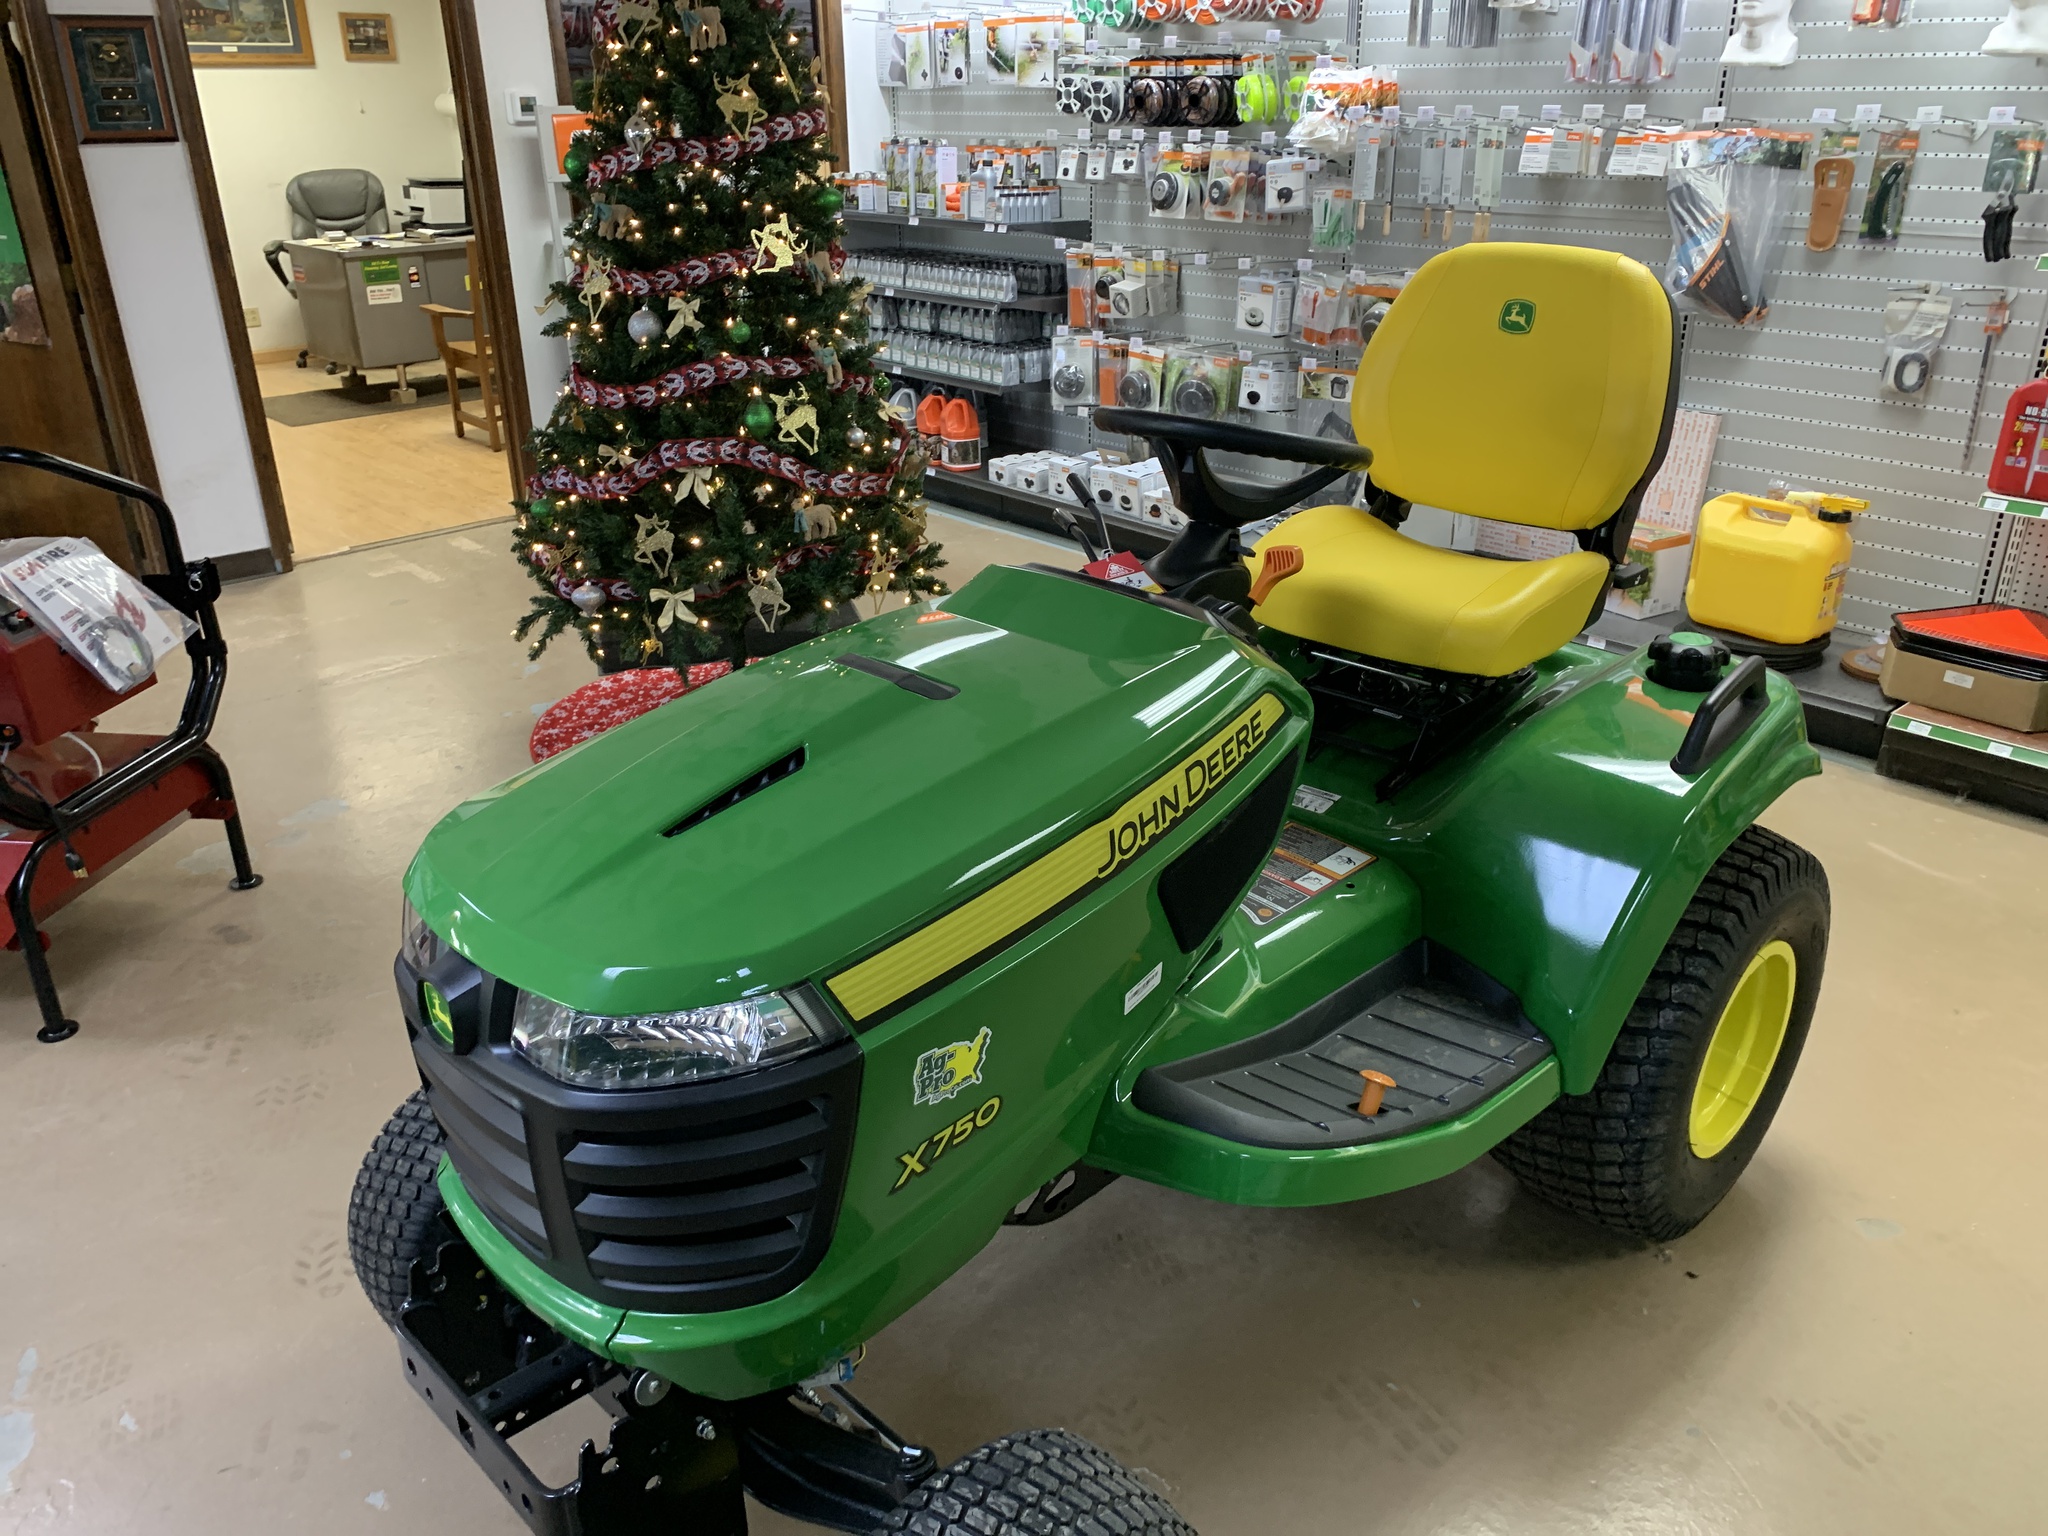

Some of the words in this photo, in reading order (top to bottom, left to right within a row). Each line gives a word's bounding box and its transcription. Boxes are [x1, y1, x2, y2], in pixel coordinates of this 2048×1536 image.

[1698, 258, 1726, 290] STIHL
[2025, 405, 2048, 418] NO-S
[1097, 784, 1181, 876] JOHN
[1184, 709, 1266, 803] DEERE
[918, 1051, 957, 1080] Ag-
[917, 1067, 957, 1100] Pro
[892, 1095, 1002, 1191] X750
